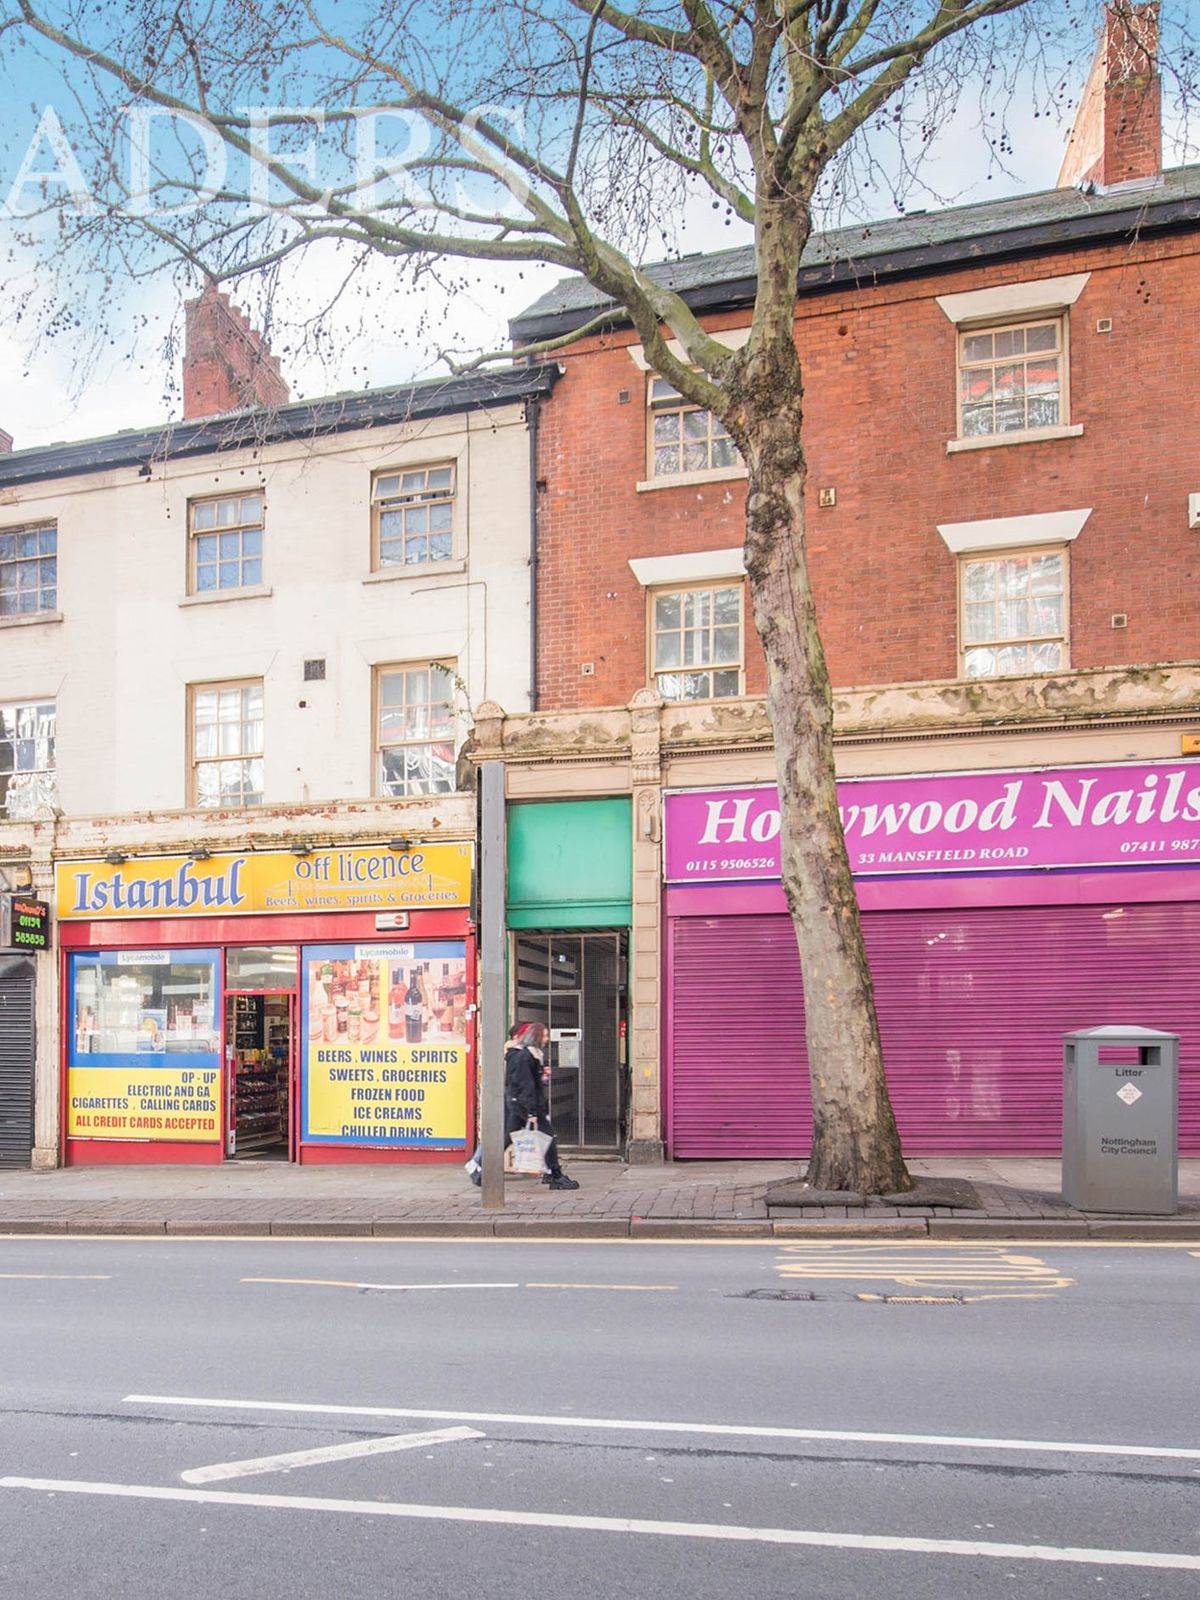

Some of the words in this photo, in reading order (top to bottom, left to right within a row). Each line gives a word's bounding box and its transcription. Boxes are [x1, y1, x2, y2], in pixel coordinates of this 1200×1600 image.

[697, 780, 1023, 846] Howood
[1033, 769, 1200, 829] Nails
[1120, 840, 1166, 854] 07411
[858, 853, 875, 865] 33
[878, 848, 975, 863] MANSFIELD
[979, 847, 1029, 860] ROAD
[338, 852, 425, 882] licence
[686, 860, 716, 872] 0115
[720, 858, 775, 870] 9506526
[71, 858, 247, 913] Istanbul
[266, 895, 299, 907] Beers,
[346, 893, 384, 906] spirits
[387, 893, 396, 902] &
[400, 890, 459, 902] Groceries
[122, 953, 165, 963] Lycamobile
[359, 947, 409, 958] Lycamobile
[317, 1050, 352, 1063] BEERS
[360, 1050, 398, 1063] WINES
[411, 1050, 458, 1063] SPIRITS
[181, 1072, 194, 1083] OP
[203, 1072, 216, 1083] UP
[329, 1069, 374, 1082] SWEETS
[382, 1069, 447, 1083] GROCERIES
[1115, 1068, 1144, 1077] Litter
[127, 1085, 172, 1097] ELECTRIC
[174, 1085, 194, 1097] AND
[196, 1085, 210, 1097] GA
[351, 1088, 392, 1101] FROZEN
[395, 1088, 425, 1101] FOOD
[72, 1098, 129, 1110] CIGARETTES
[140, 1098, 180, 1111] CALLING
[182, 1099, 216, 1112] CARDS
[353, 1107, 372, 1119] ICE
[374, 1107, 422, 1120] CREAMS
[75, 1115, 91, 1127] ALL
[93, 1116, 127, 1128] CREDIT
[129, 1117, 163, 1129] CARDS
[165, 1118, 215, 1130] ACCEPTED
[341, 1125, 387, 1136] CHILLED
[389, 1127, 433, 1138] DRINKS
[1101, 1137, 1156, 1148] Nottingham
[1101, 1146, 1119, 1156] City
[1121, 1146, 1157, 1155] Council
